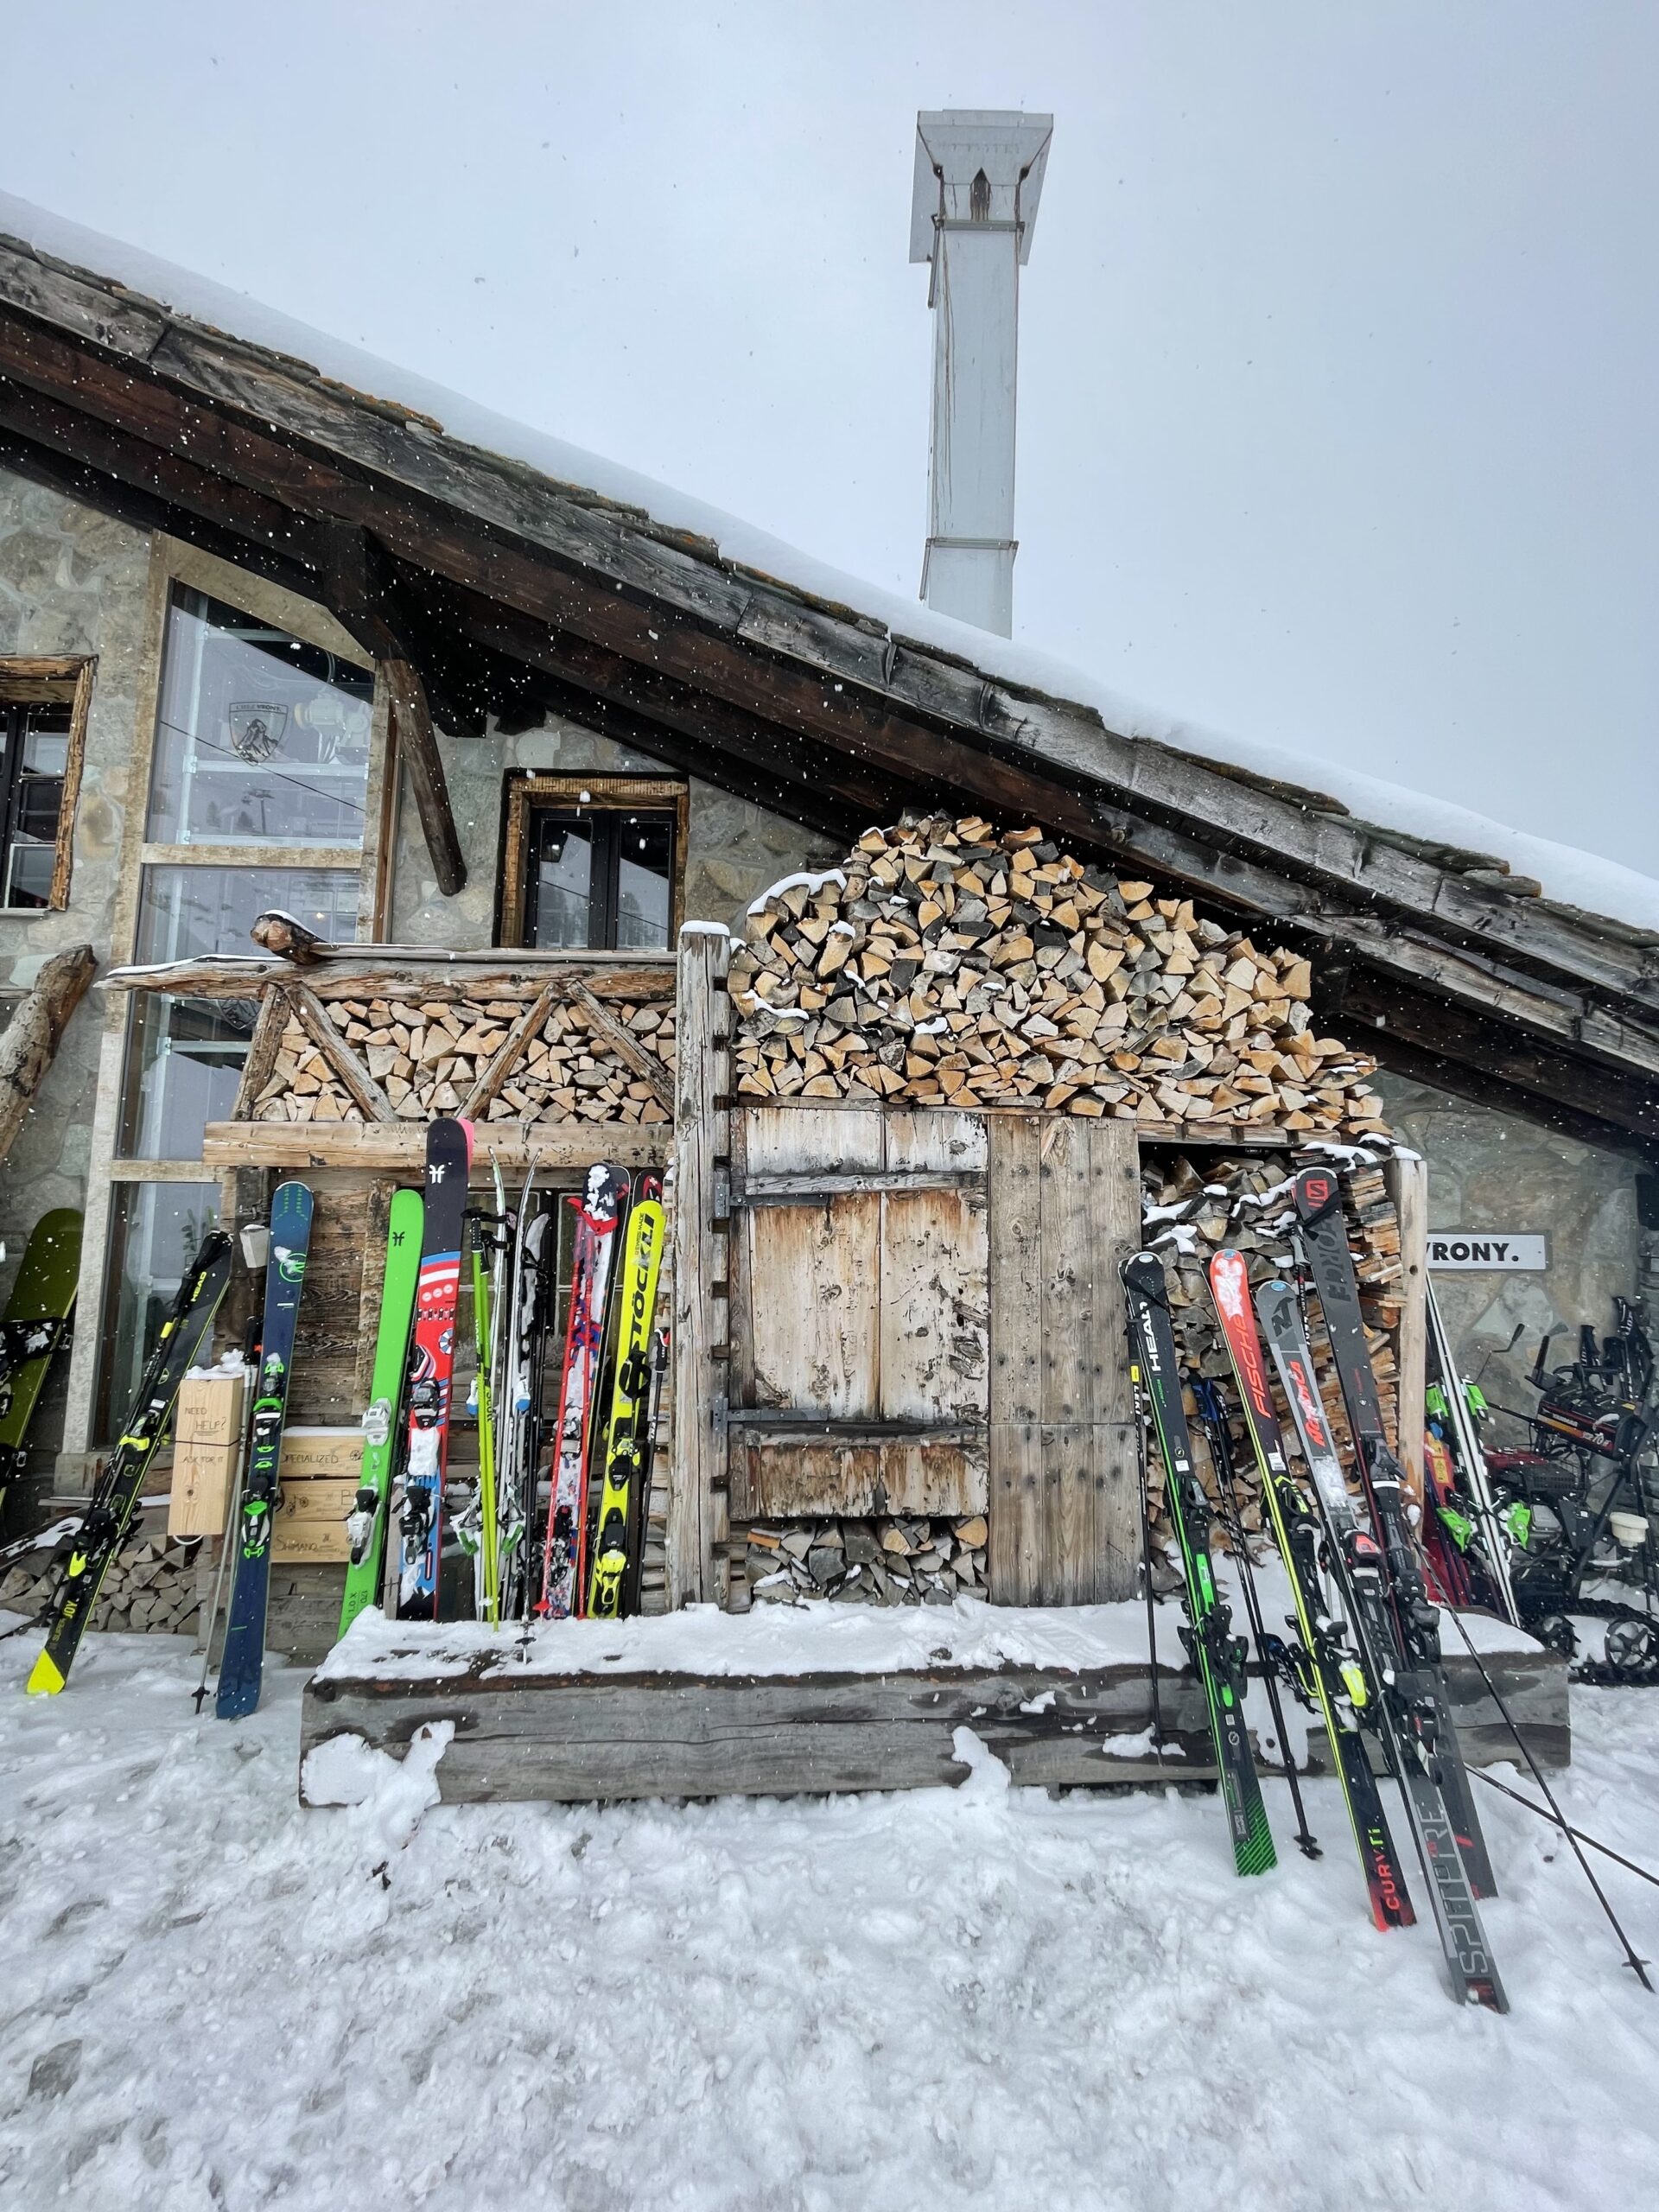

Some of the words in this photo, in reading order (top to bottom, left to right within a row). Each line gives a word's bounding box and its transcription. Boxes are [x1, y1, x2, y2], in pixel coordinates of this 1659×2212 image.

[1233, 1314, 1272, 1419] FISCHE
[195, 1416, 226, 1430] HELP?
[63, 1600, 78, 1619] JOY
